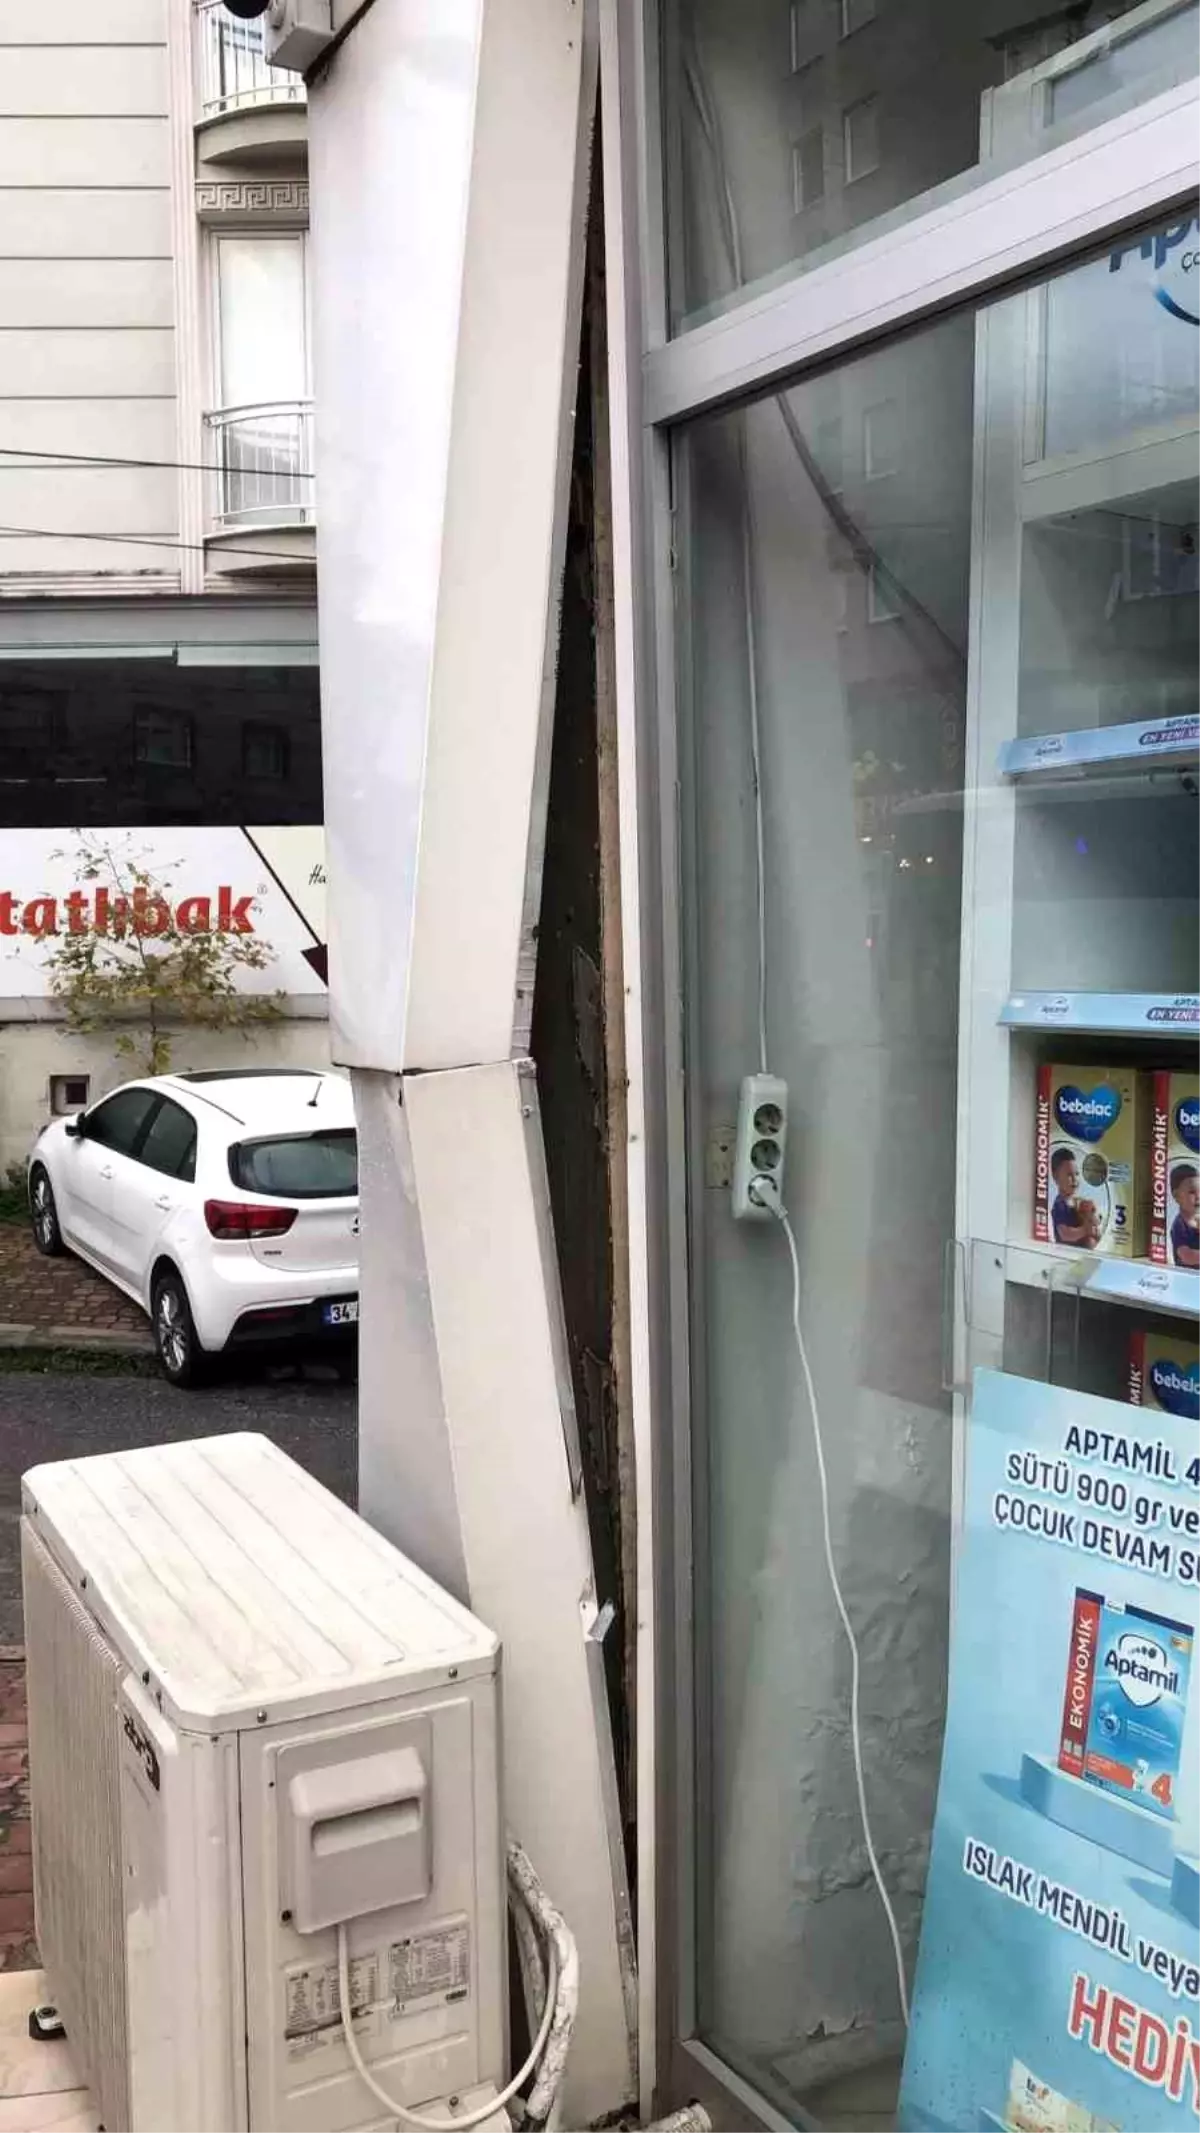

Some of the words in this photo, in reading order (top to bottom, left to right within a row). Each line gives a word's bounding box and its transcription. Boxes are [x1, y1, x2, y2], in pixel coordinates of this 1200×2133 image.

[1059, 1097, 1112, 1117] bebelac
[1180, 1109, 1200, 1126] be
[1115, 1205, 1126, 1225] 3
[332, 1304, 350, 1321] 34
[1064, 1425, 1176, 1480] APTAMİL
[1185, 1457, 1200, 1486] 4
[1007, 1452, 1070, 1494] SÜTÜ
[1076, 1473, 1127, 1511] 900
[1135, 1496, 1163, 1525] gr
[1169, 1505, 1200, 1534] ve
[994, 1493, 1076, 1543] ÇOCUK
[1083, 1520, 1170, 1573] DEVAM
[1179, 1550, 1200, 1582] S
[1069, 1616, 1094, 1729] EKONOMİK
[1103, 1648, 1179, 1695] Aptamil
[1151, 1772, 1172, 1807] 4
[966, 1840, 1033, 1902] ISLAK
[1038, 1879, 1130, 1958] MENDİL
[1139, 1940, 1200, 1996] veya
